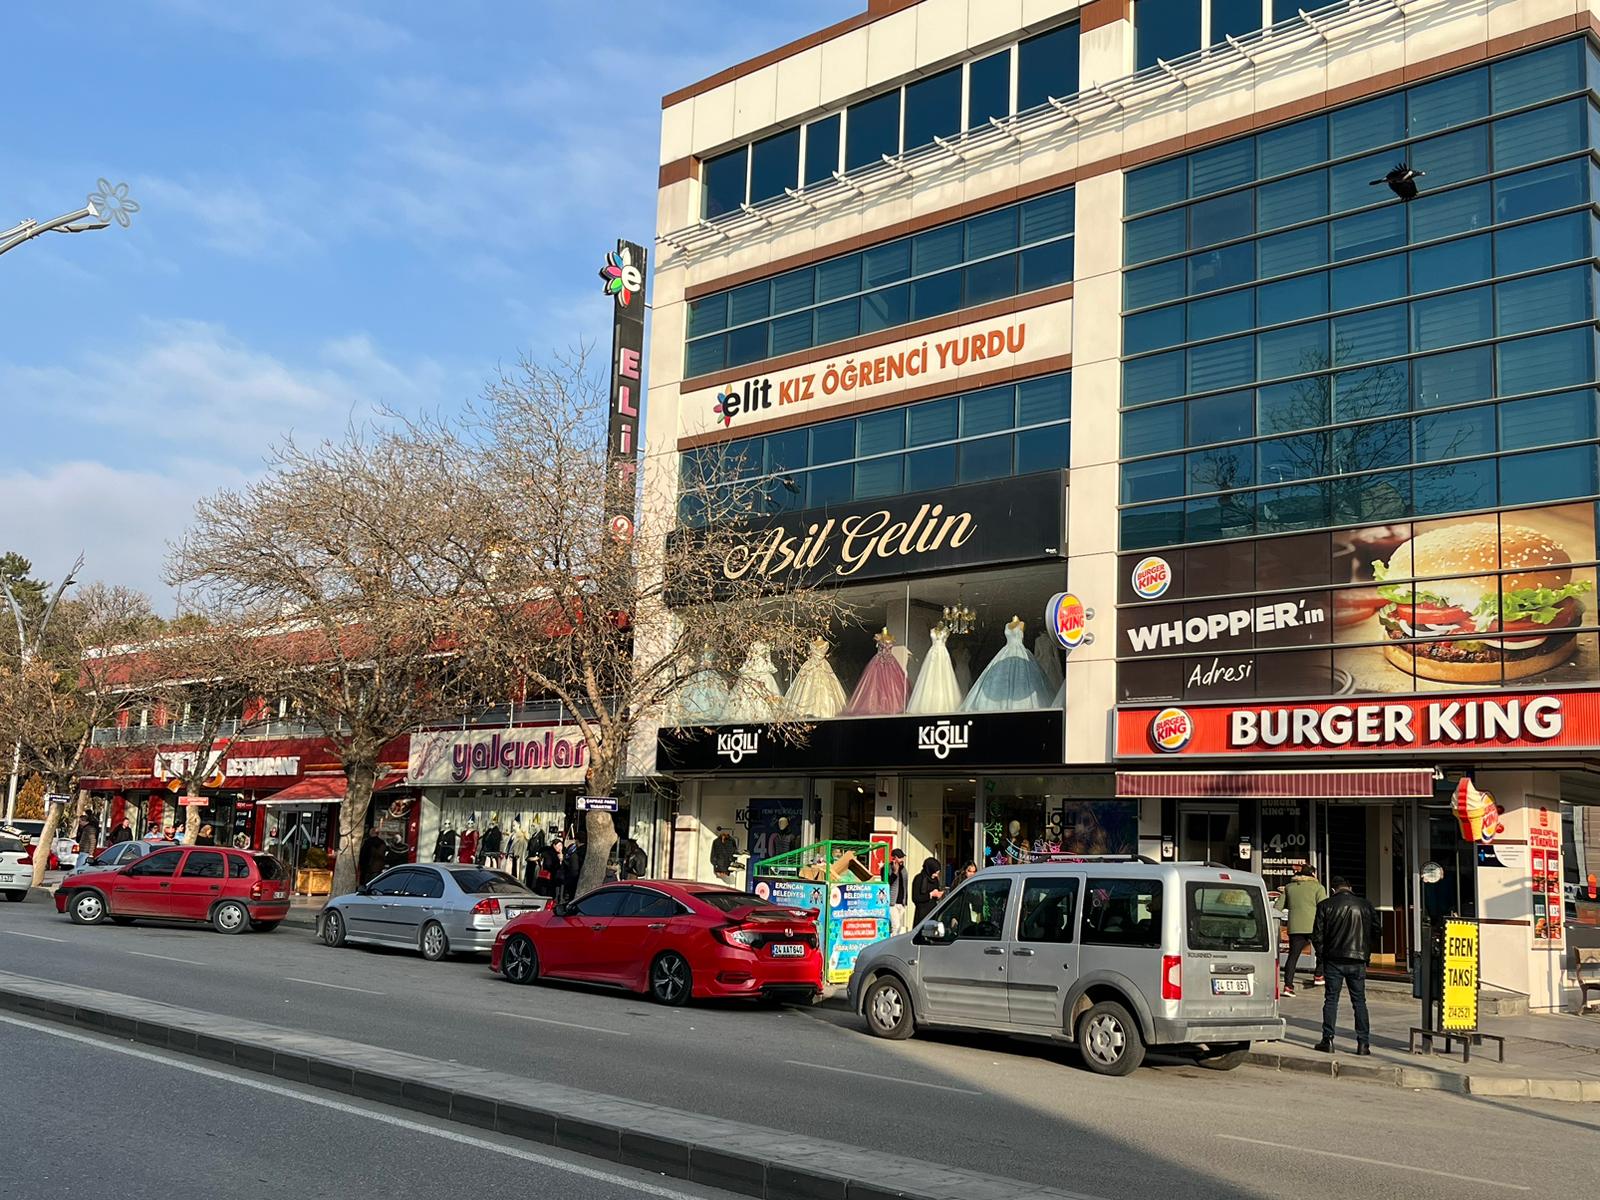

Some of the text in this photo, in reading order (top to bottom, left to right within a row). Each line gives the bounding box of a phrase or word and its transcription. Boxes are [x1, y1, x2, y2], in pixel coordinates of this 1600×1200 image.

[721, 323, 1026, 418] elit KIZ ÖĞRENCİ YURDU
[722, 503, 978, 580] Asil Gelin
[1137, 563, 1165, 580] BURGER
[1138, 571, 1167, 590] KING
[1060, 616, 1085, 633] KING
[1187, 657, 1254, 689] Adresi
[1156, 714, 1186, 731] BURGER
[1231, 696, 1563, 746] BURGER KING
[1156, 723, 1187, 743] KING
[451, 731, 588, 783] yalçınlar
[1449, 937, 1474, 957] EREN
[1448, 965, 1474, 987] TAKSİ
